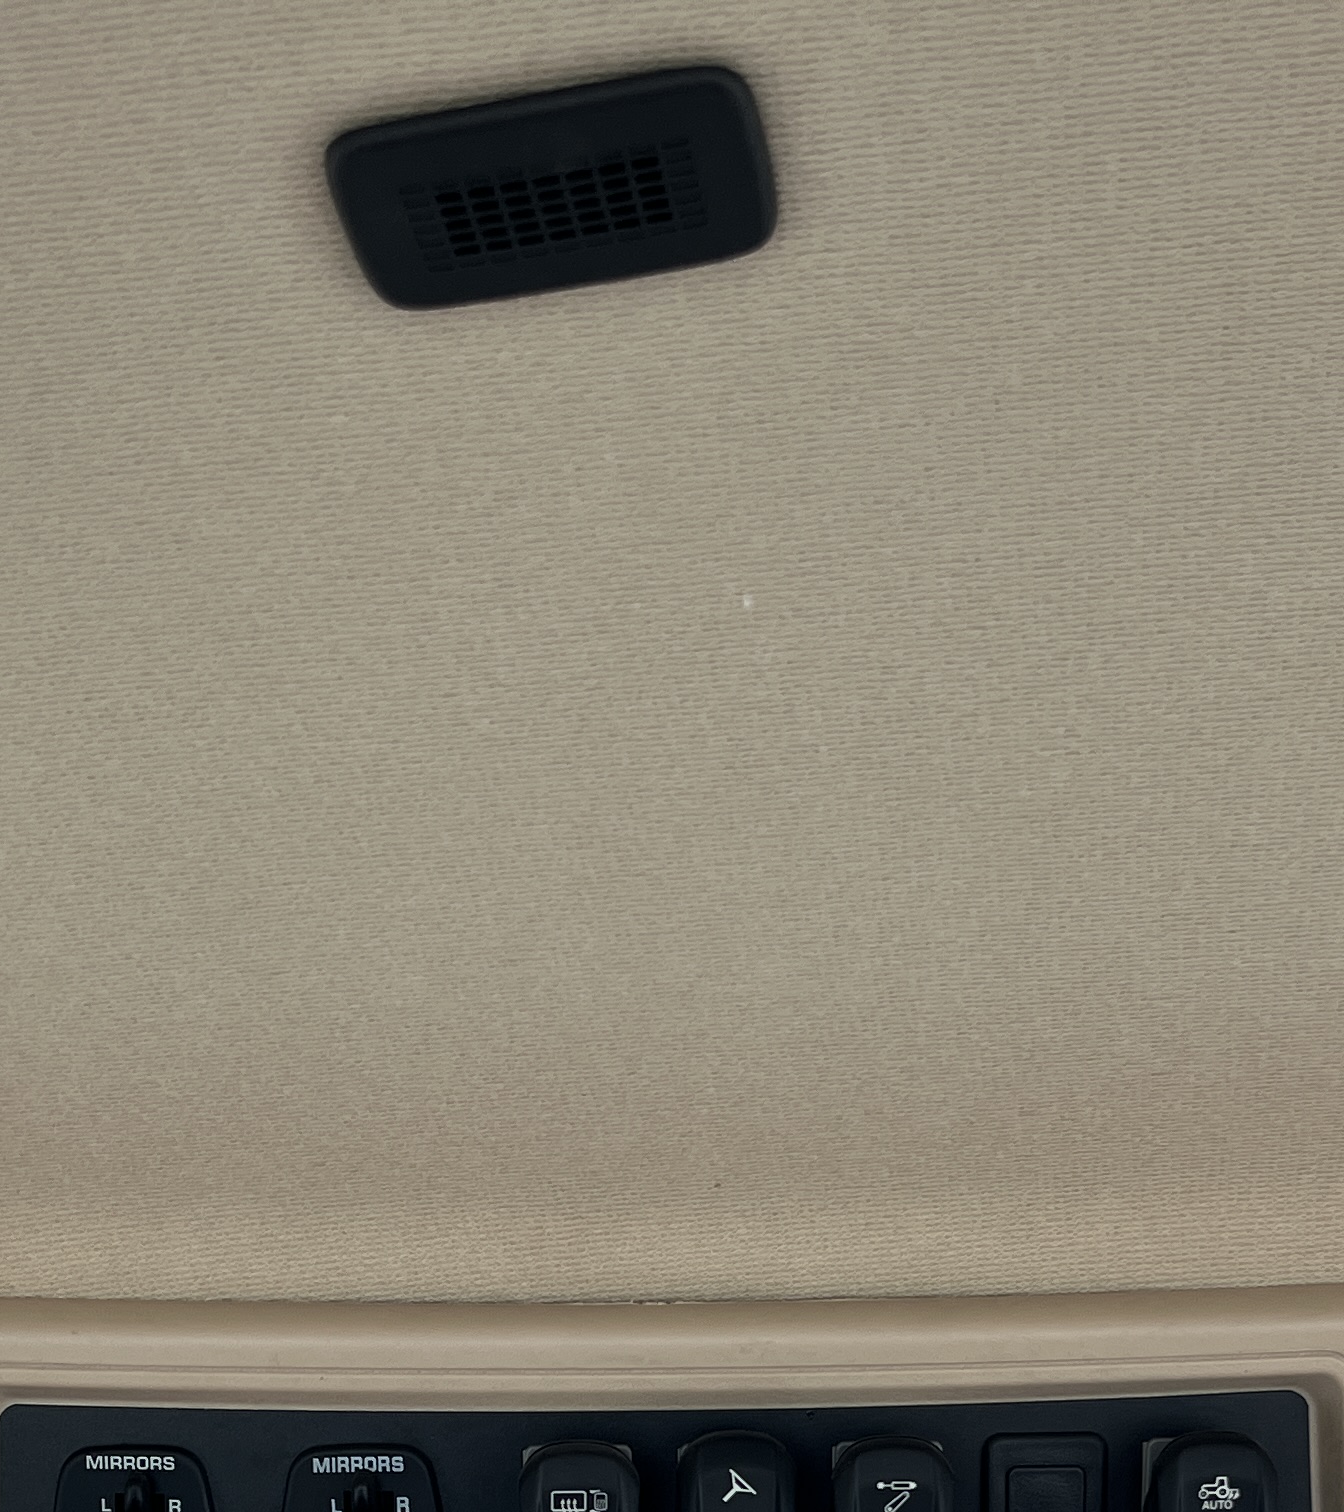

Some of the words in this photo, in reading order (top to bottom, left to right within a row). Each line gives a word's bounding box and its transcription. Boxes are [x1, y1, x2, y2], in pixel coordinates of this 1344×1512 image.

[85, 1454, 175, 1471] MIRRORS
[312, 1455, 405, 1474] MIRRORS
[100, 1497, 112, 1512] L
[168, 1498, 182, 1512] R
[1201, 1498, 1234, 1511] AUTO
